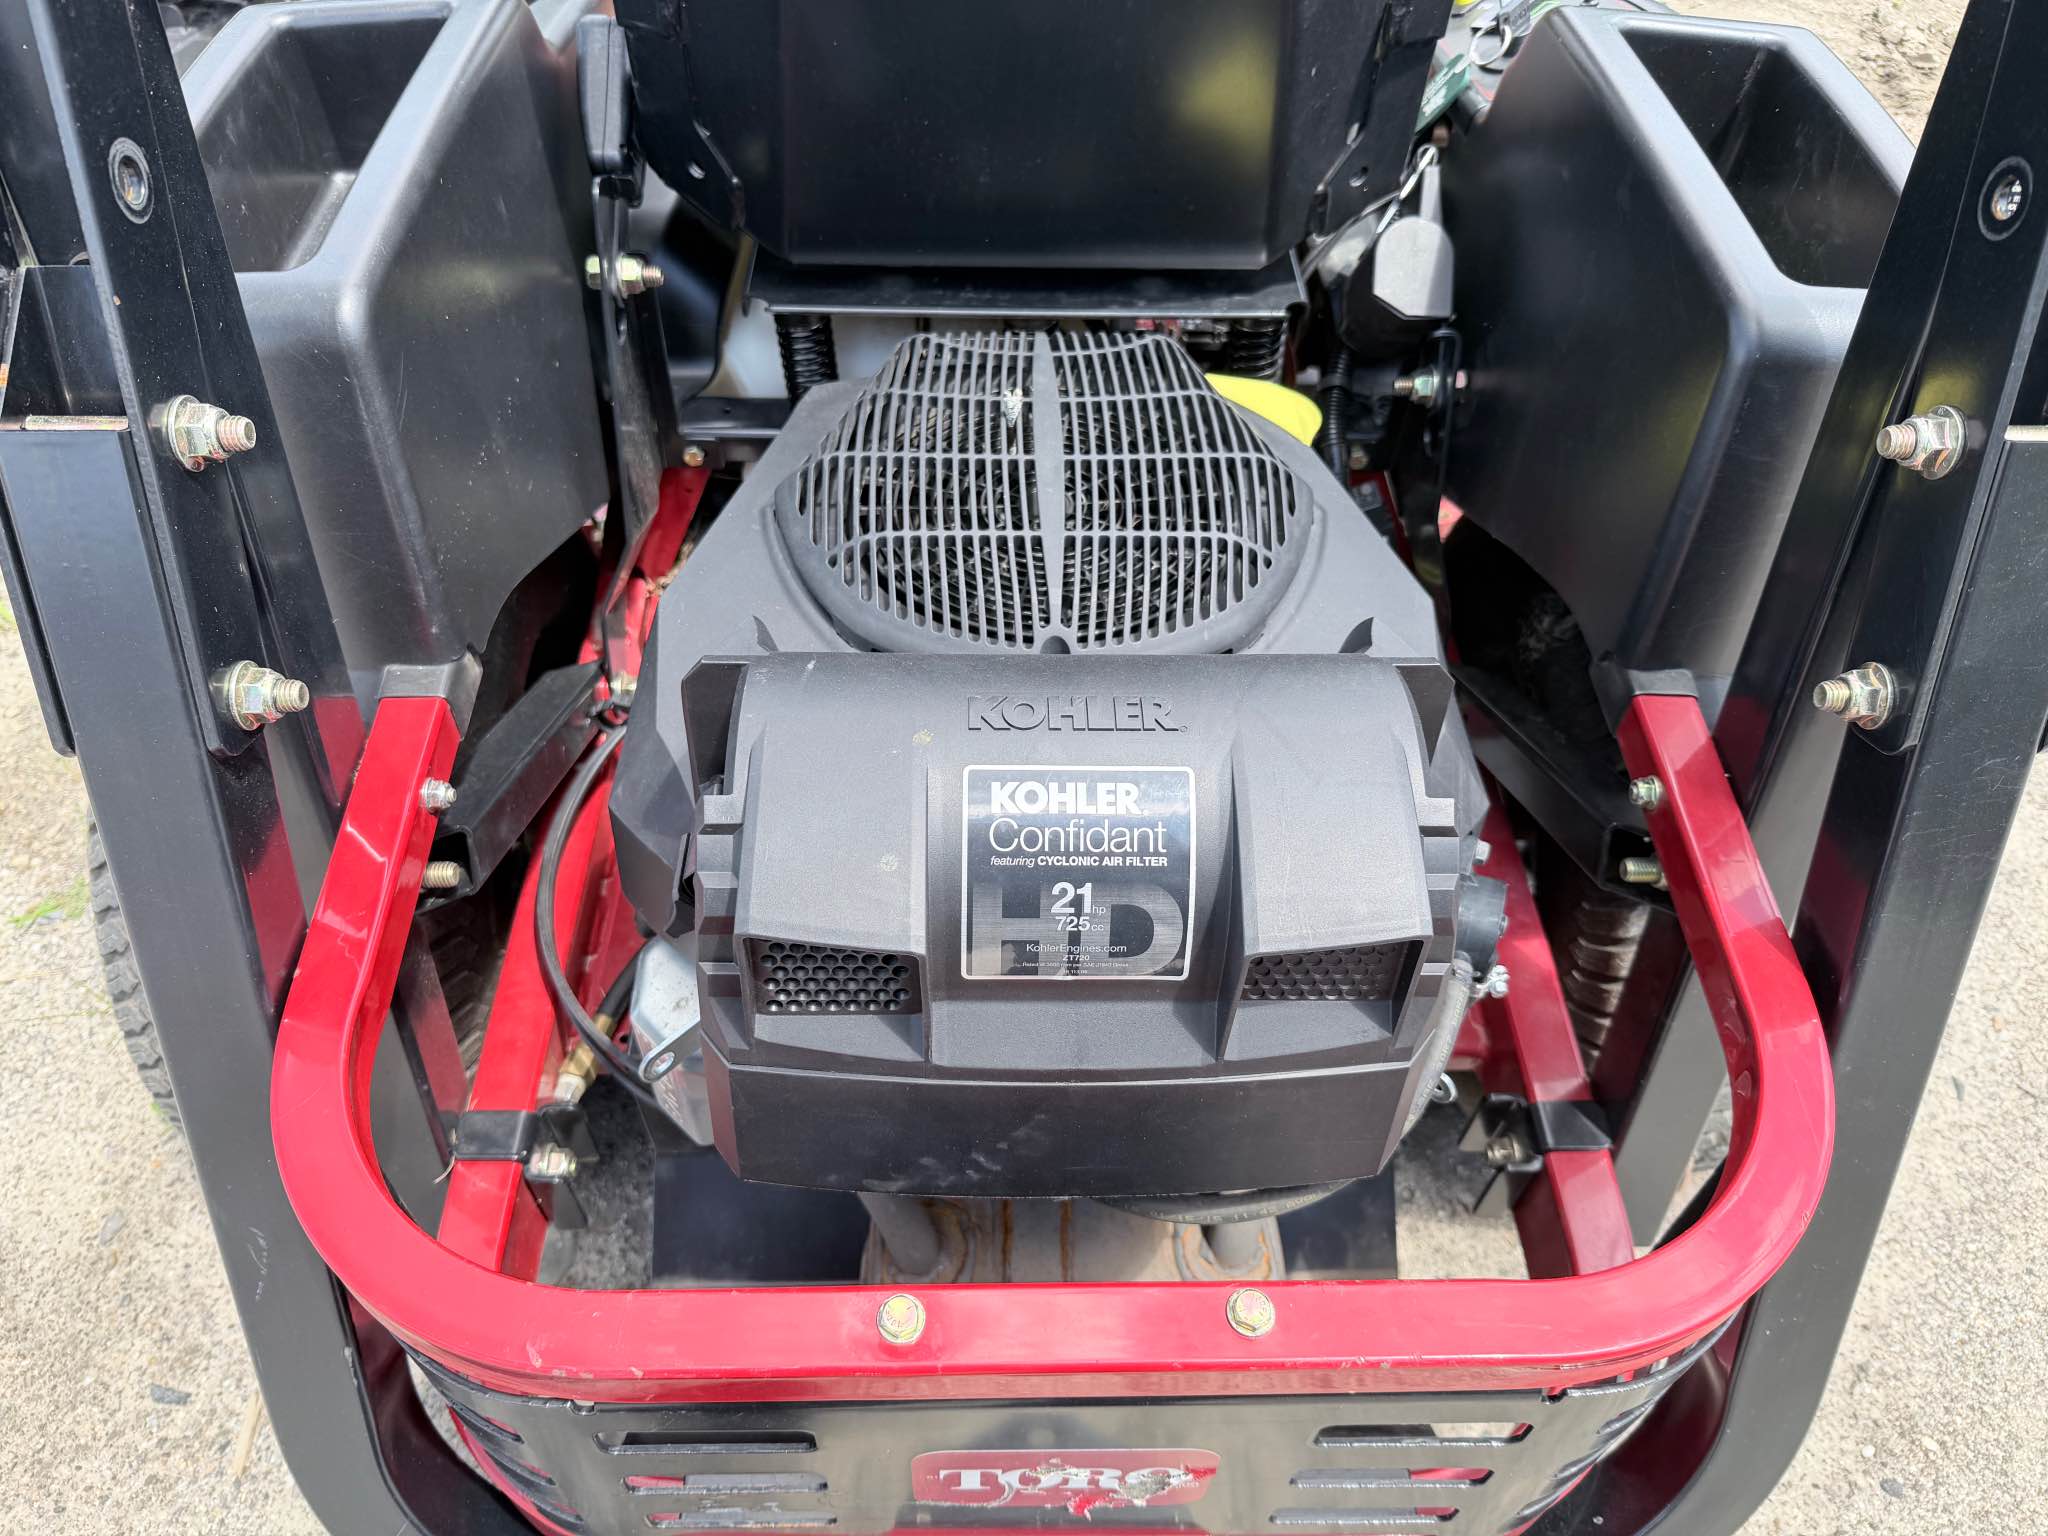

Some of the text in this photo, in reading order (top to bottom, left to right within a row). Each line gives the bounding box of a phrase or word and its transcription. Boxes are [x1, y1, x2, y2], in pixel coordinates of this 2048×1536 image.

[967, 696, 1180, 731] KOHLER
[990, 781, 1144, 815] KOHLER
[989, 818, 1168, 852] Confidant
[990, 855, 1168, 868] featuring CYCLONIC AIR FILTER
[1051, 882, 1106, 916] 21 hp
[1055, 916, 1104, 932] 725 cc
[1026, 943, 1127, 954] KohlerEngines.com
[1062, 954, 1090, 962] ZT720
